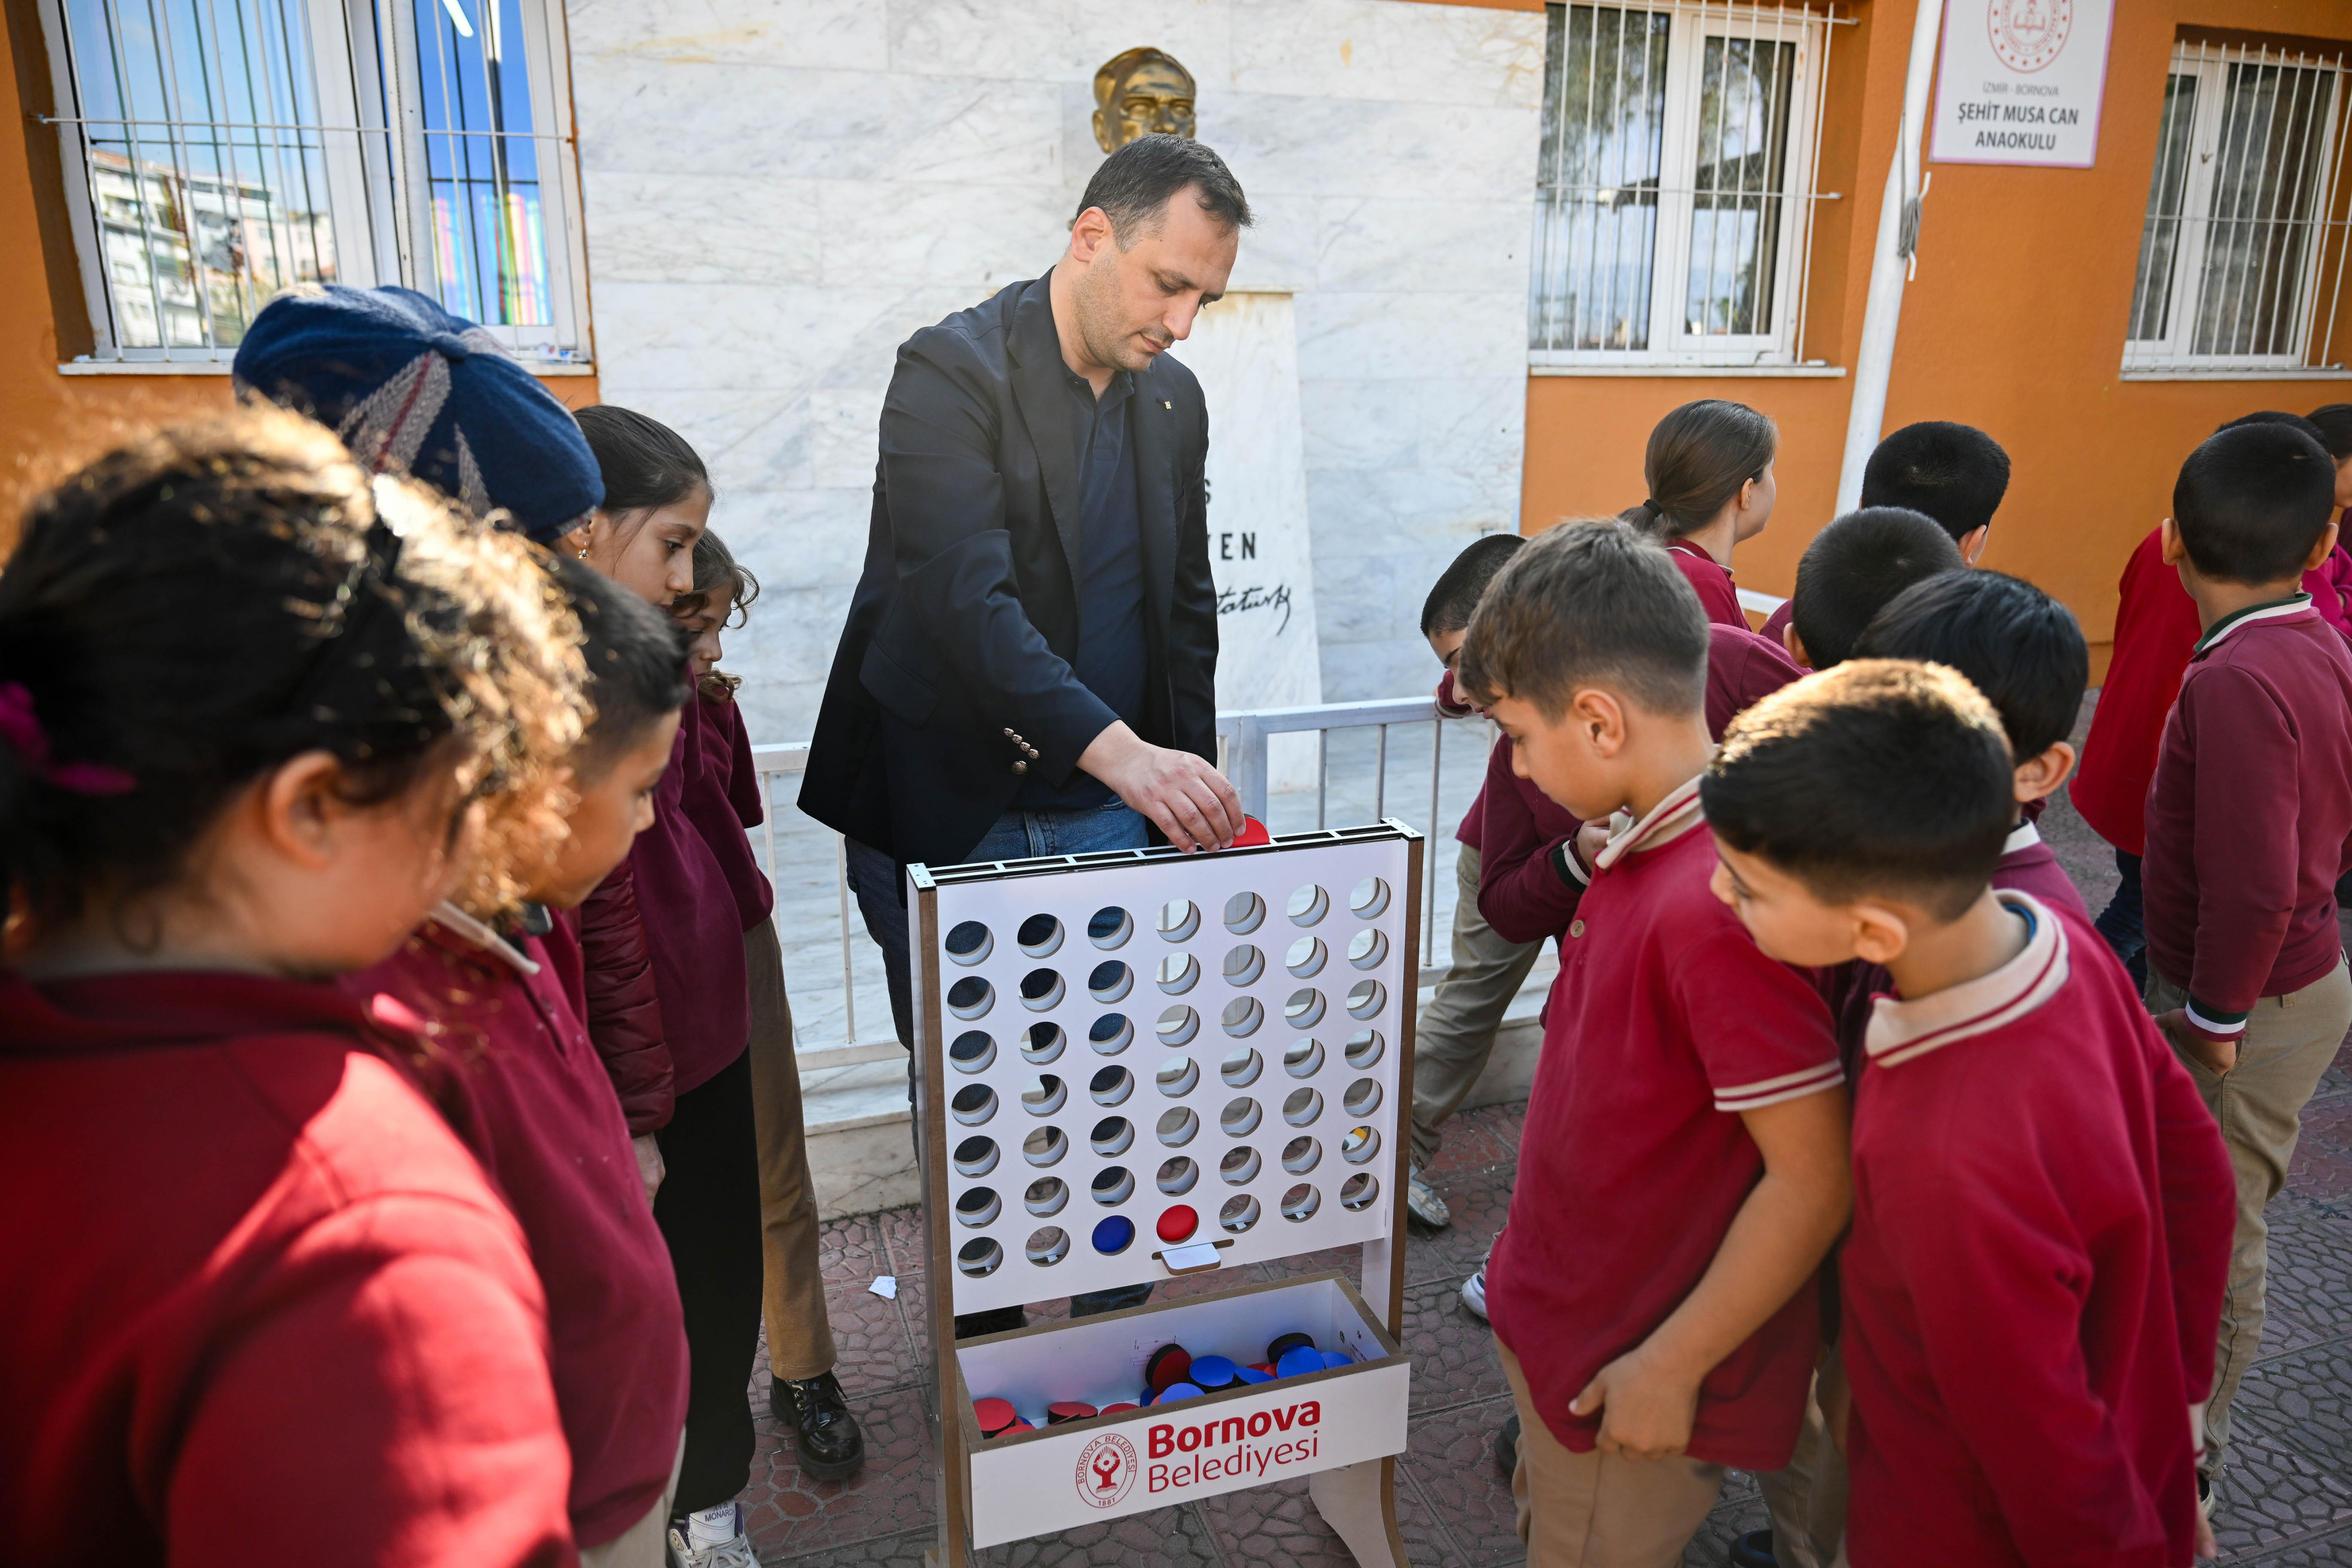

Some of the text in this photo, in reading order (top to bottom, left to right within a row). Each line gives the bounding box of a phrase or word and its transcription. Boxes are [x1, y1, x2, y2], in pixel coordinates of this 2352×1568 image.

[2016, 83, 2059, 97] BORNOVA
[1958, 101, 2079, 125] ŞEHİT MUSA CAN
[1975, 131, 2056, 150] ANAOKULU
[1207, 532, 1256, 560] EN
[1149, 1400, 1321, 1458] Bornova
[1077, 1436, 1135, 1484] BORNOVA BELEDİYESİ
[1149, 1430, 1318, 1493] Belediyesi
[1098, 1497, 1115, 1506] 1881
[705, 1508, 735, 1522] MONARCH
